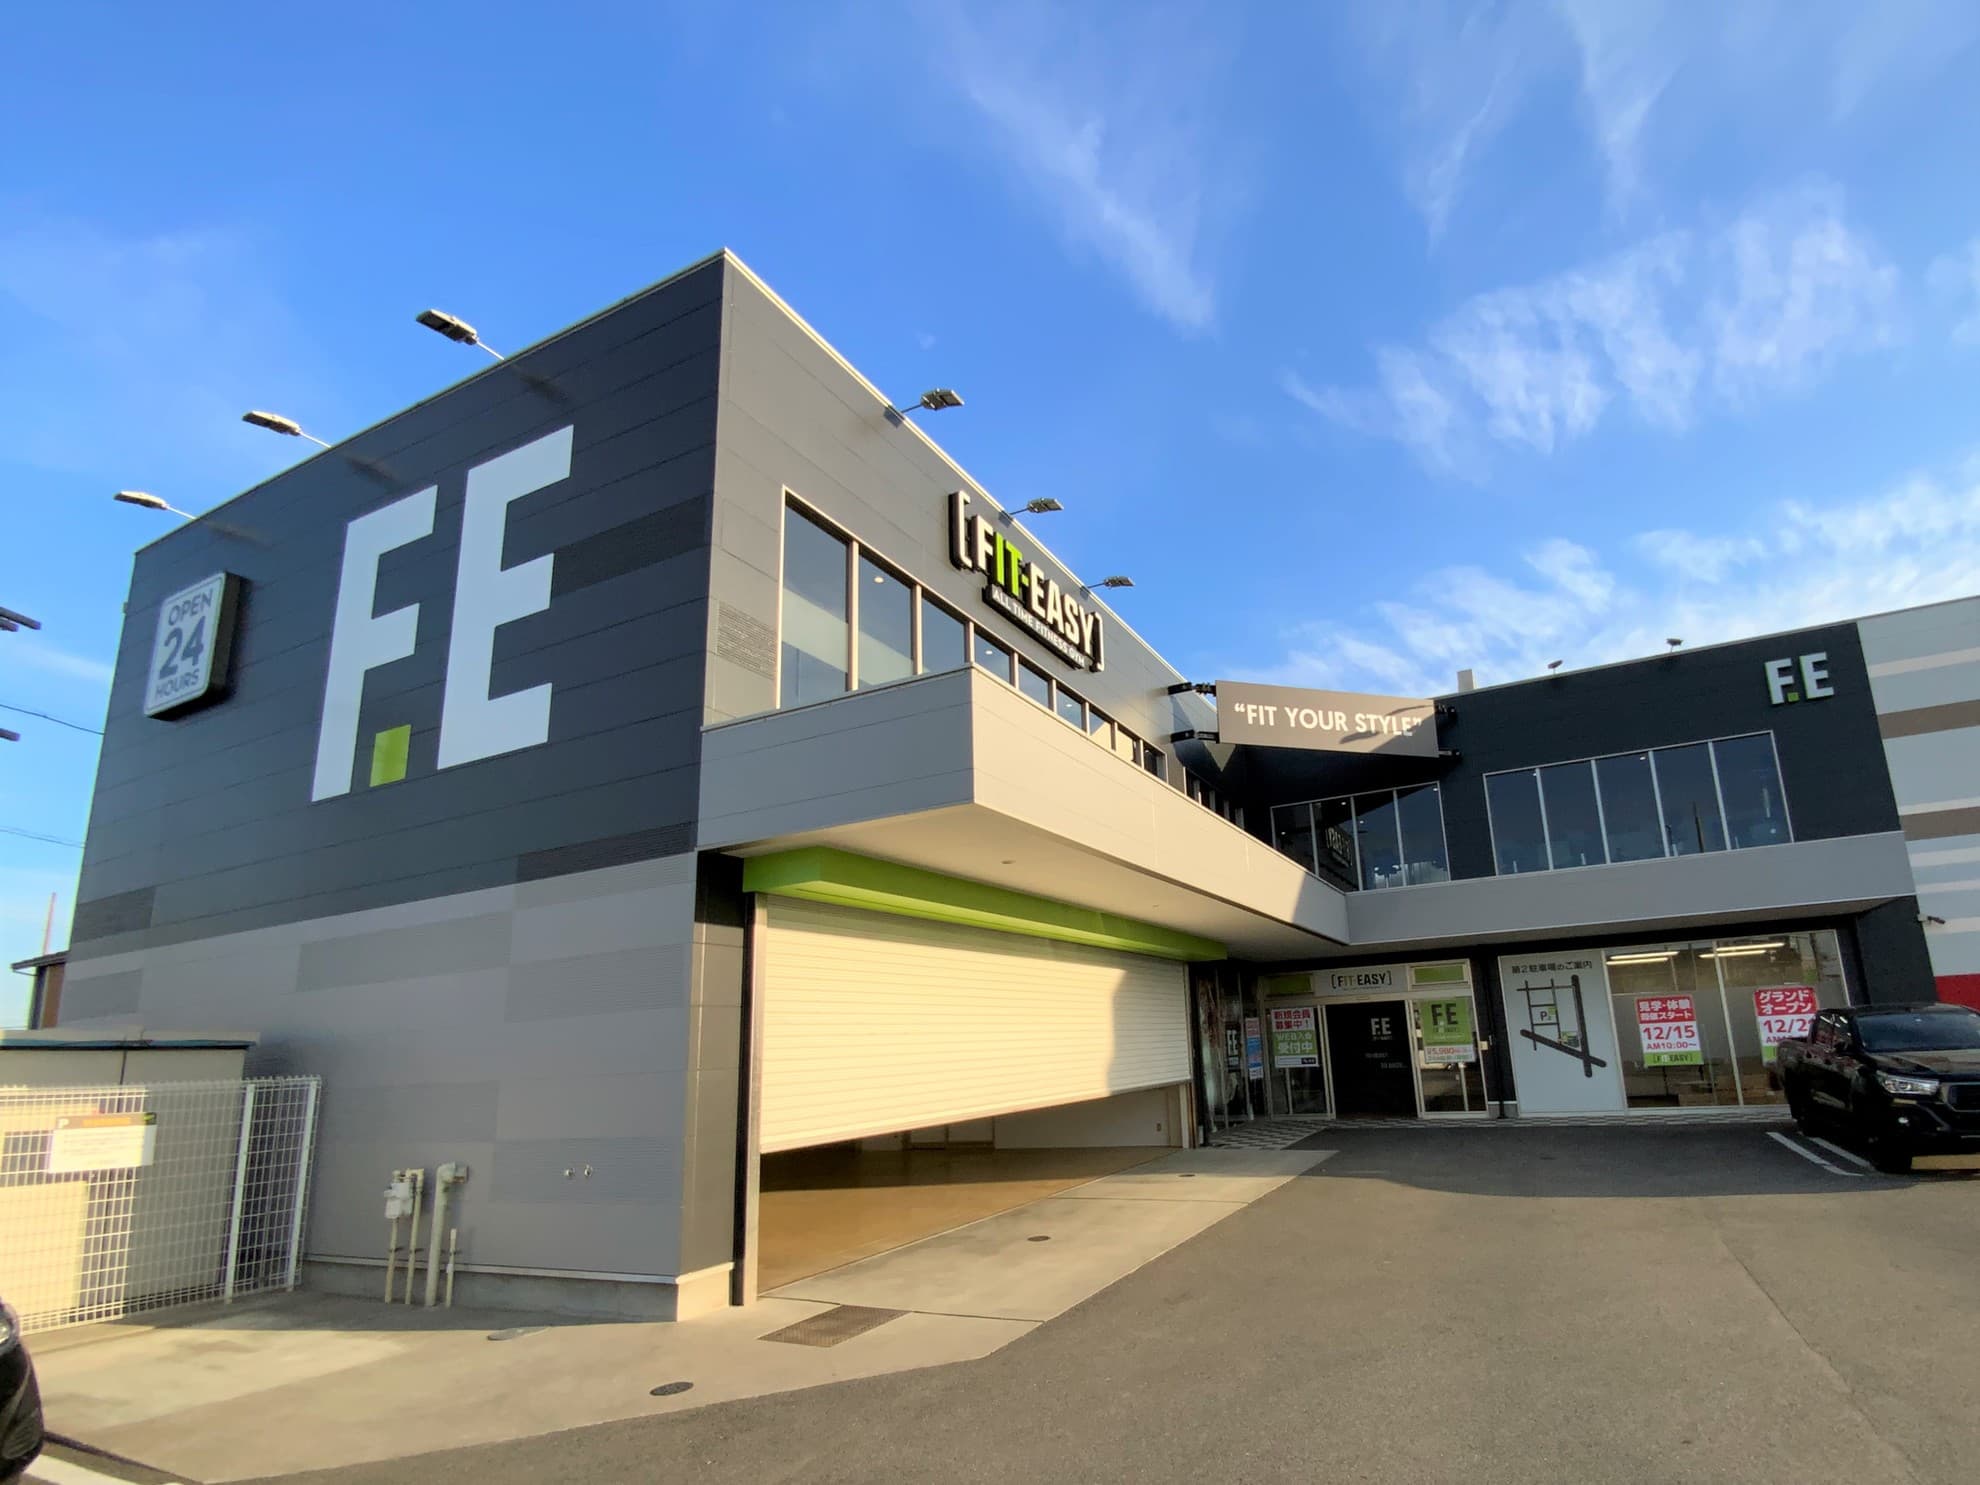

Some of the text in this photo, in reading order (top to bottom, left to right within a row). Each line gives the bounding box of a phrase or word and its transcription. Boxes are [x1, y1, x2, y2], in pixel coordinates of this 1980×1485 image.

[168, 588, 213, 627] OPEN
[992, 588, 1085, 668] ALL TIME FITNESS GYM
[159, 615, 206, 680] 24
[155, 668, 200, 699] HOURS
[1284, 706, 1348, 732] YOUR
[1759, 989, 1809, 1004] グランド
[1760, 1001, 1812, 1015] オープン
[1643, 1025, 1696, 1041] 12/15
